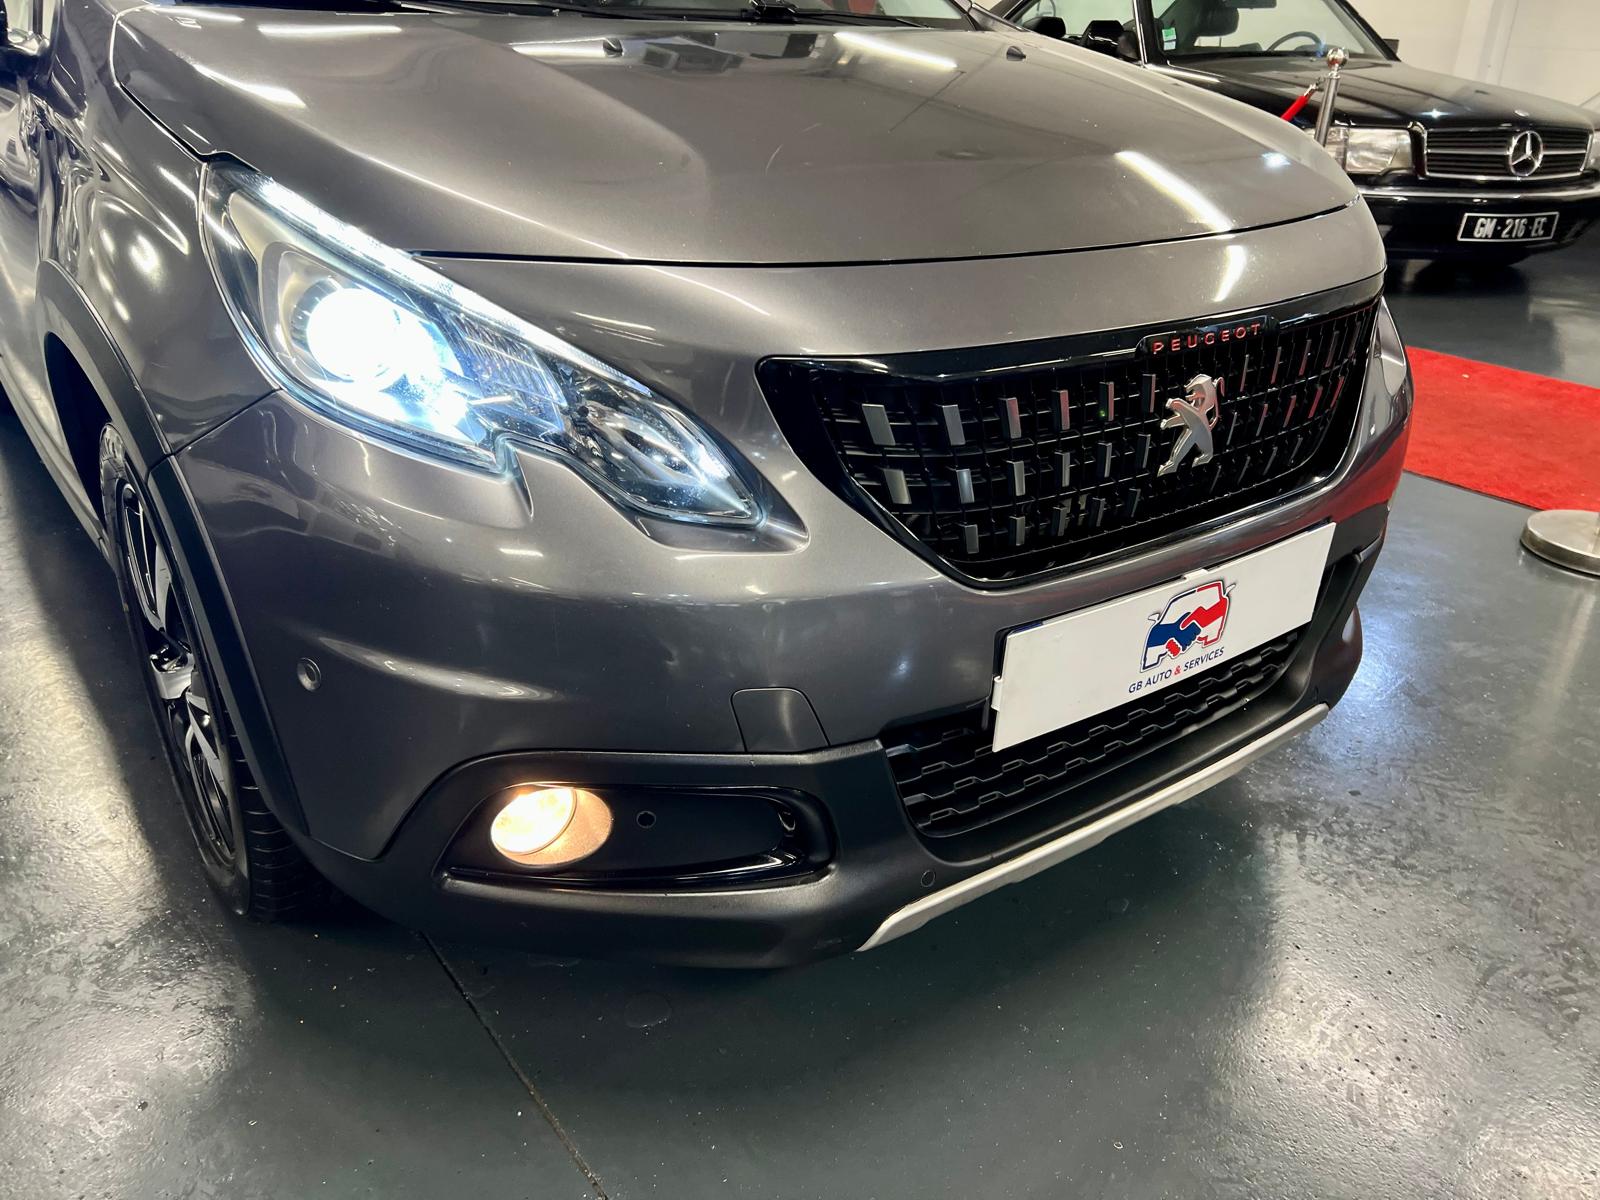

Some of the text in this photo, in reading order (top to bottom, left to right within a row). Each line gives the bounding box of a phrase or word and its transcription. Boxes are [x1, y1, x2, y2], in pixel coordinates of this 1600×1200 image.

[1501, 217, 1528, 238] 216
[1531, 217, 1548, 237] EC
[1152, 323, 1260, 355] PEUGEOT
[1128, 646, 1224, 693] GB AUTO & SERVICES
